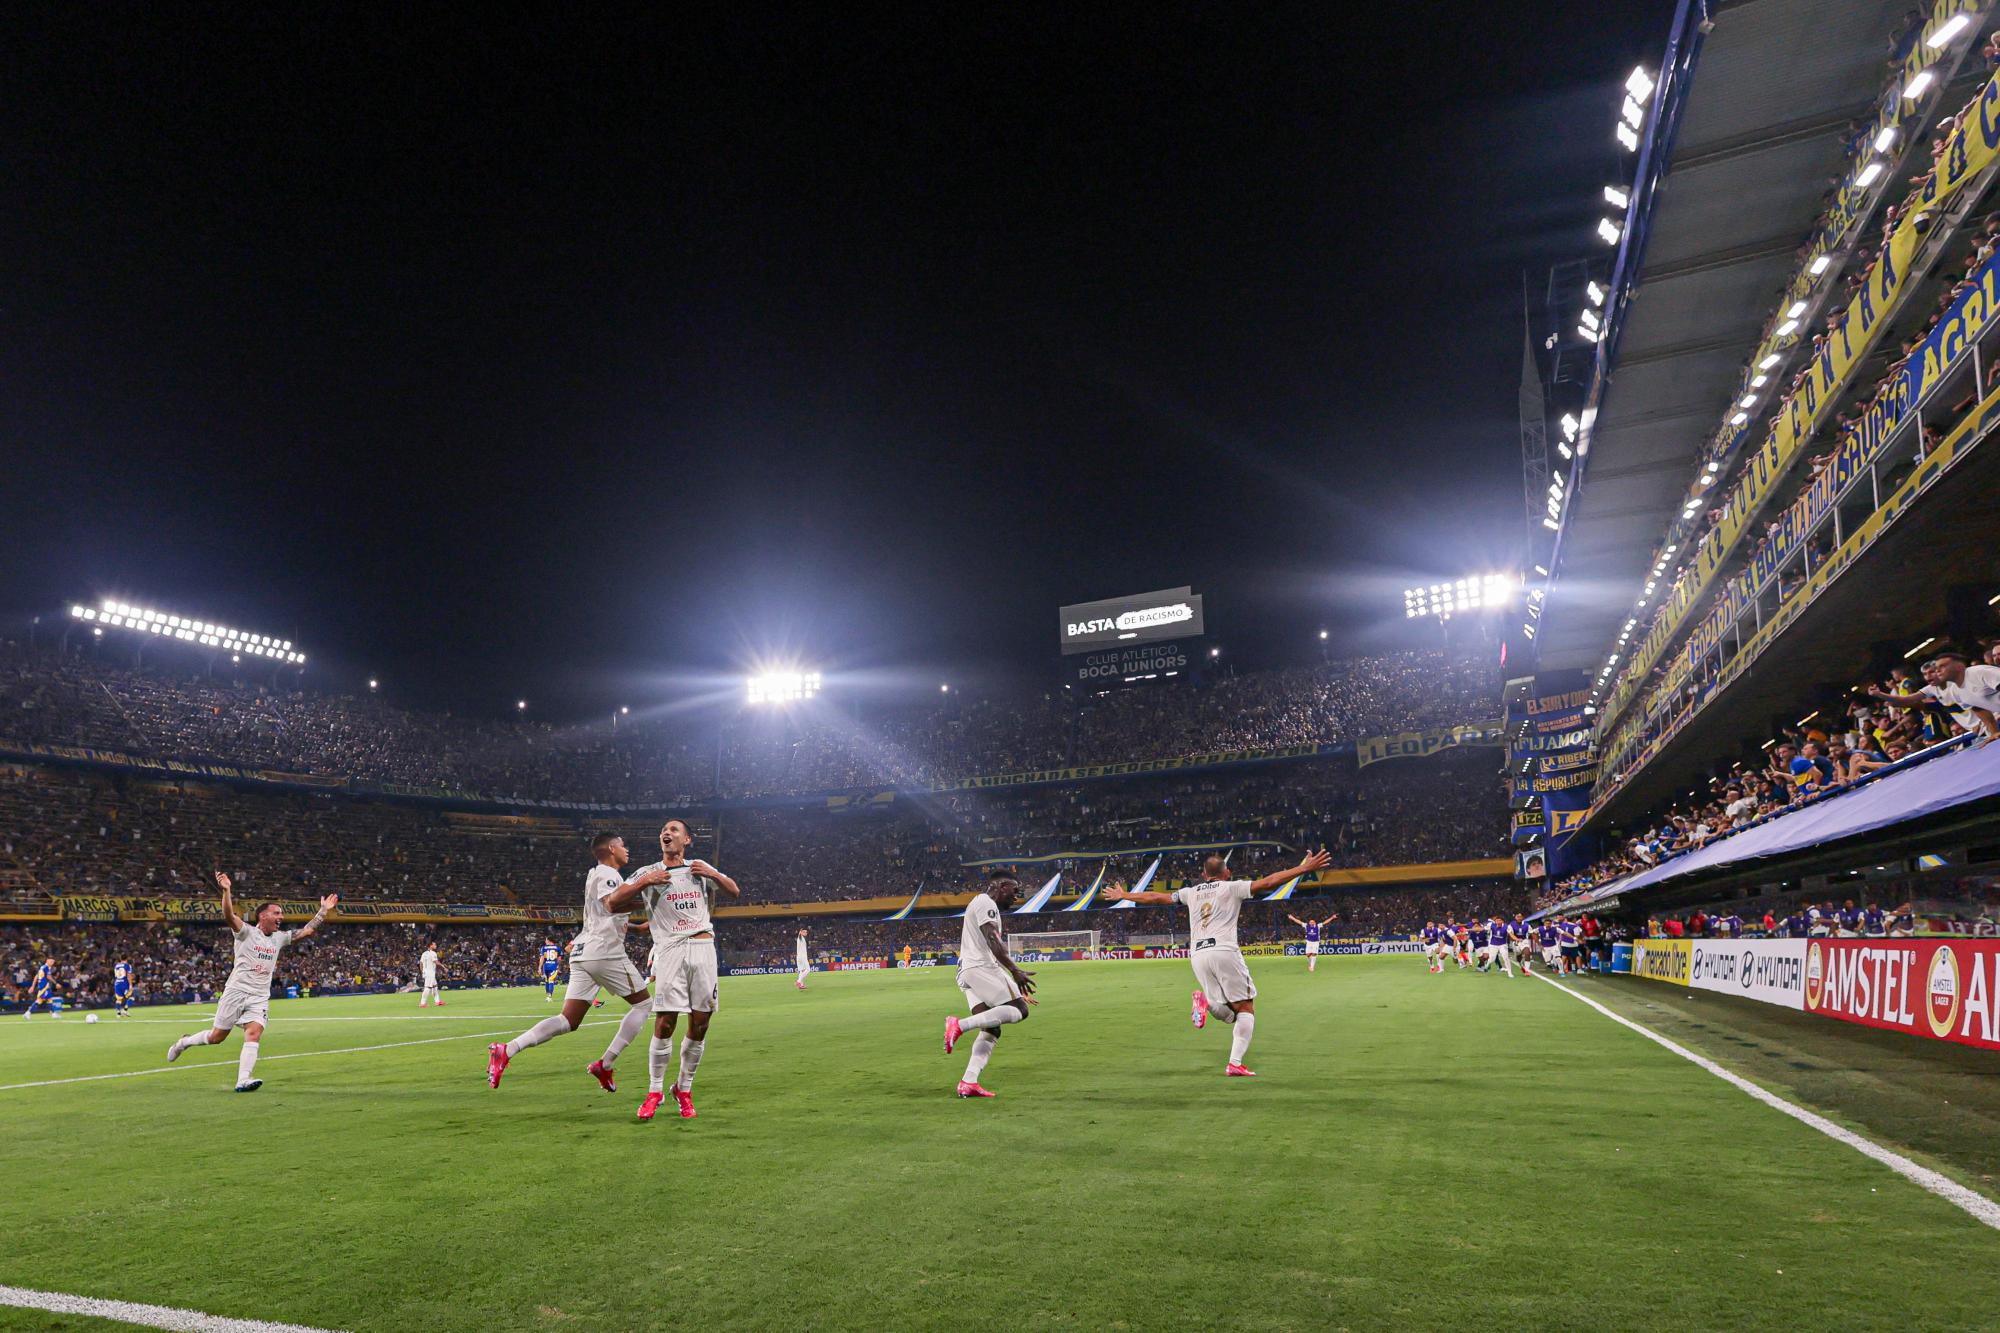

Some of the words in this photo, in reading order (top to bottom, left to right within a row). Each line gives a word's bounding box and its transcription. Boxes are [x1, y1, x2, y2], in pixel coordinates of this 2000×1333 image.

[1791, 242, 1898, 438] CONTRA
[1067, 617, 1115, 636] BASTA
[1124, 617, 1136, 625] DE
[1139, 609, 1183, 623] RACISMO
[1086, 653, 1119, 666] CLUB
[1079, 665, 1118, 679] BOCA
[1122, 655, 1187, 673] JUNIORS
[1558, 751, 1593, 765] RIBERA
[980, 768, 1071, 787] HINCHADA
[667, 890, 701, 902] apuesta
[63, 899, 118, 912] MARCOS
[675, 900, 697, 910] total
[1094, 950, 1134, 960] AMSTEL
[1264, 946, 1283, 955] libre
[1388, 943, 1426, 953] HYUND
[841, 962, 881, 971] MAPFRE
[1646, 950, 1671, 977] mercado
[1704, 953, 1738, 982] HYUNDAI
[730, 967, 768, 976] CONMEBOL
[1756, 956, 1803, 992] HYUNDAI
[1823, 947, 1914, 1026] AMSTEL
[1933, 978, 1953, 992] AMSTEL
[1935, 995, 1950, 1006] LAGER
[1960, 952, 2000, 1042] A
